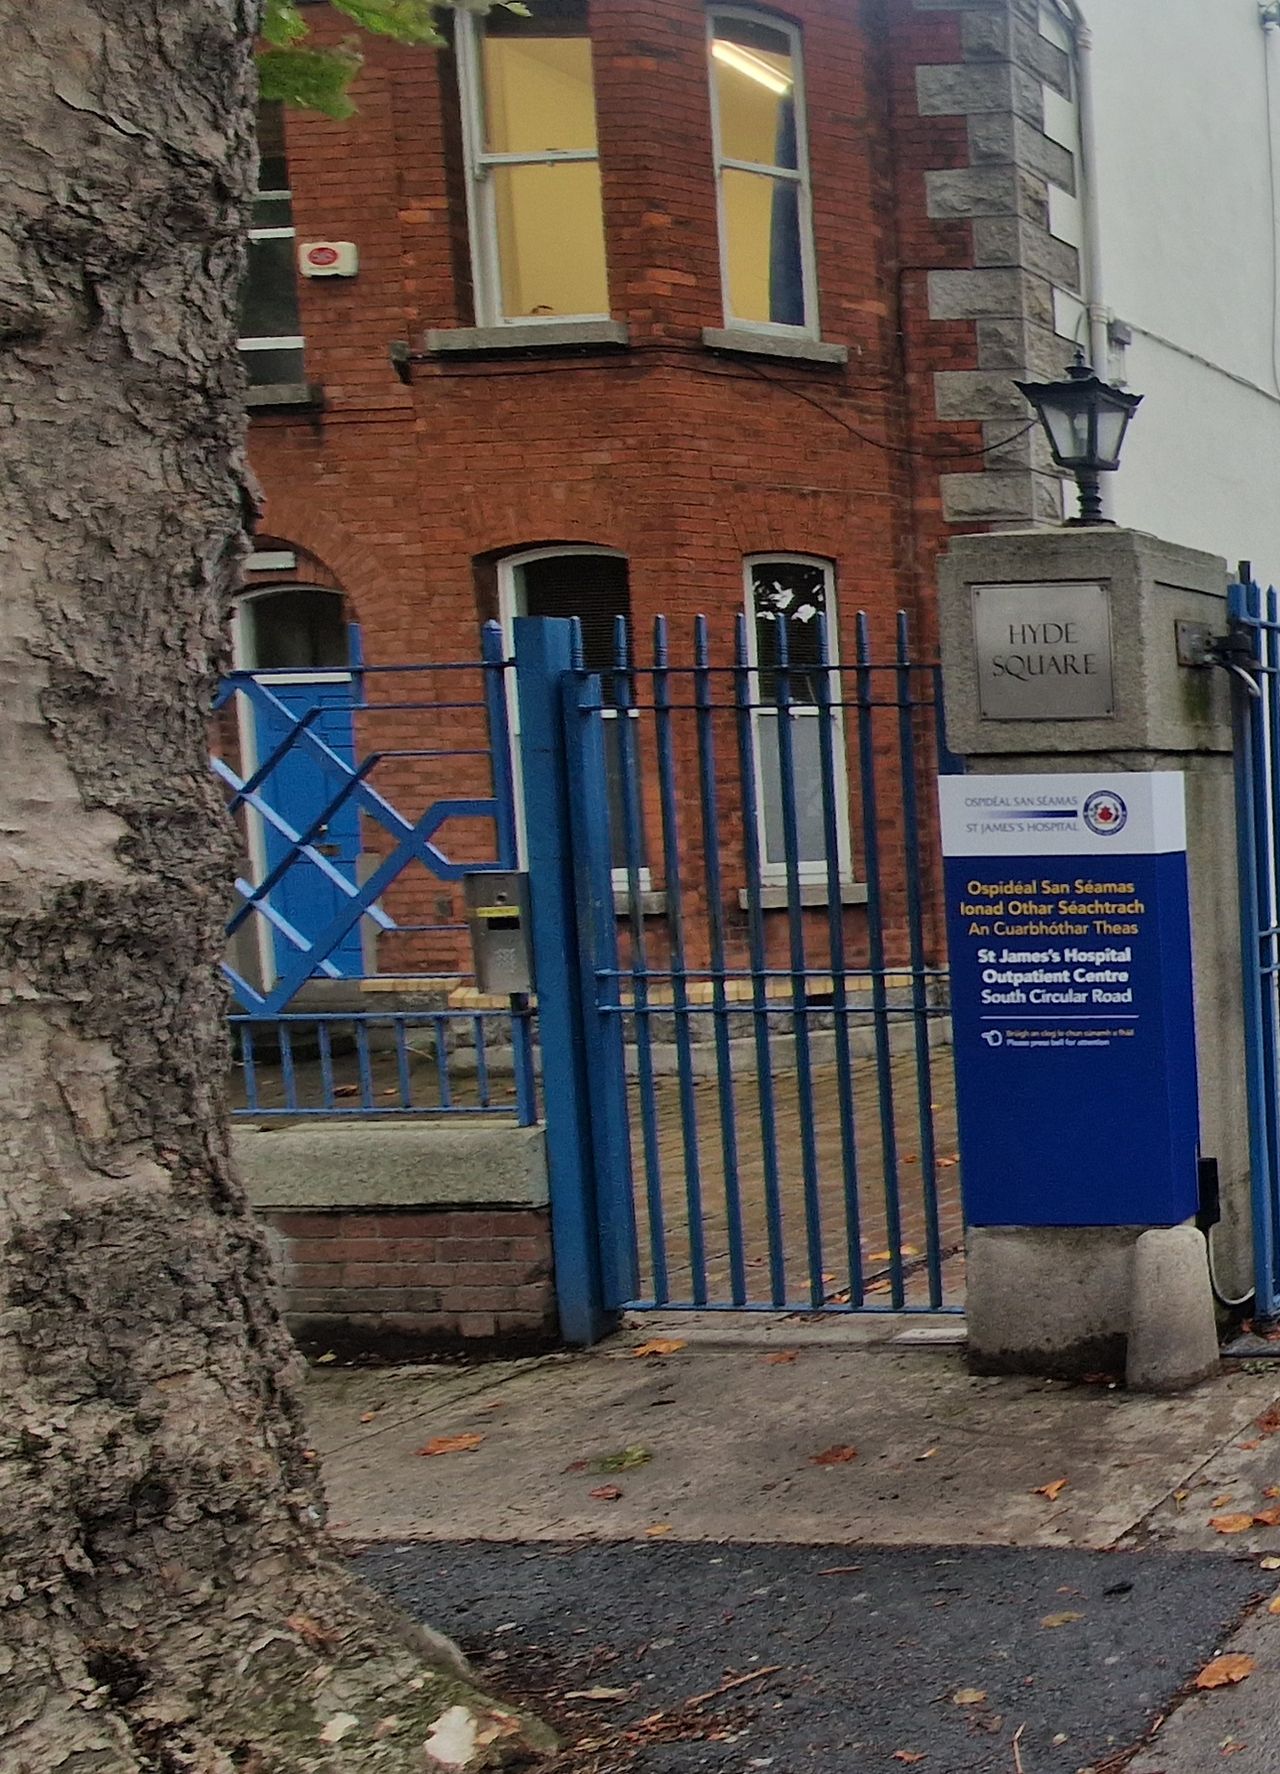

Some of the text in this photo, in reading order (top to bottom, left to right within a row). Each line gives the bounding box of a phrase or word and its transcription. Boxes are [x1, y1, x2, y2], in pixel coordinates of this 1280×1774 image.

[1008, 622, 1078, 644] HYDE
[992, 653, 1097, 681] SQUARE
[1011, 796, 1036, 806] SAN
[1037, 795, 1078, 806] SÉAMAS
[966, 823, 978, 833] ST
[1027, 822, 1078, 833] HOSPITAL
[967, 879, 1135, 898] Ospidéal San Séamas
[960, 899, 1145, 915] Ionad Othar Séachtrach
[968, 920, 1139, 936] An Cuarbhóthar Theas
[978, 947, 1131, 966] St James's Hospital
[982, 968, 1129, 987] Outpatient Centre
[981, 988, 1133, 1004] South Circular Road
